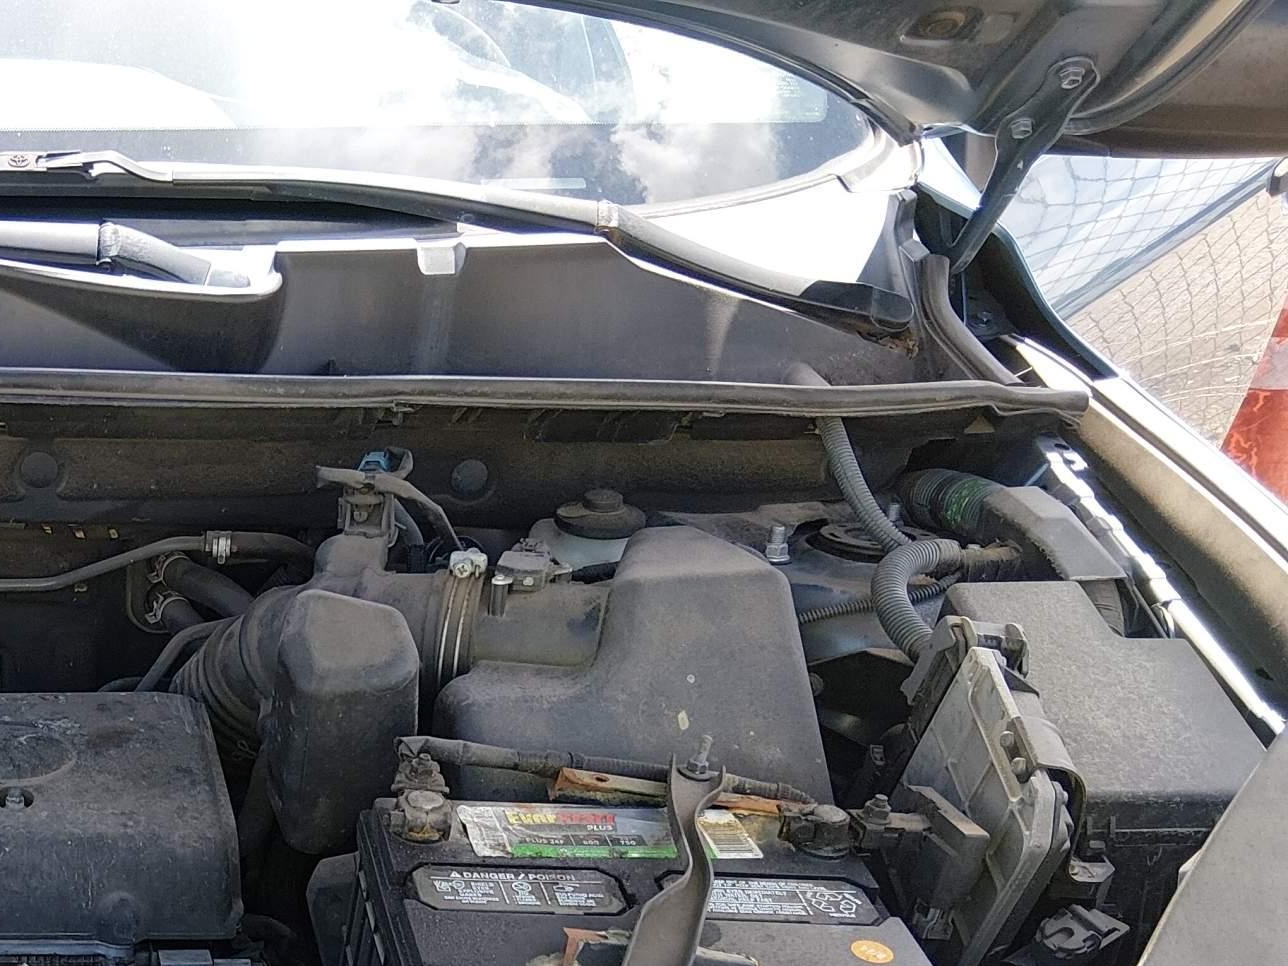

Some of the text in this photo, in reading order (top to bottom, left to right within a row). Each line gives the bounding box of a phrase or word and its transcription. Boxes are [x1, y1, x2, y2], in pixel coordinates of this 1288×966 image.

[586, 824, 614, 832] PLUS
[462, 871, 516, 881] DANGER
[528, 873, 577, 882] POISON
